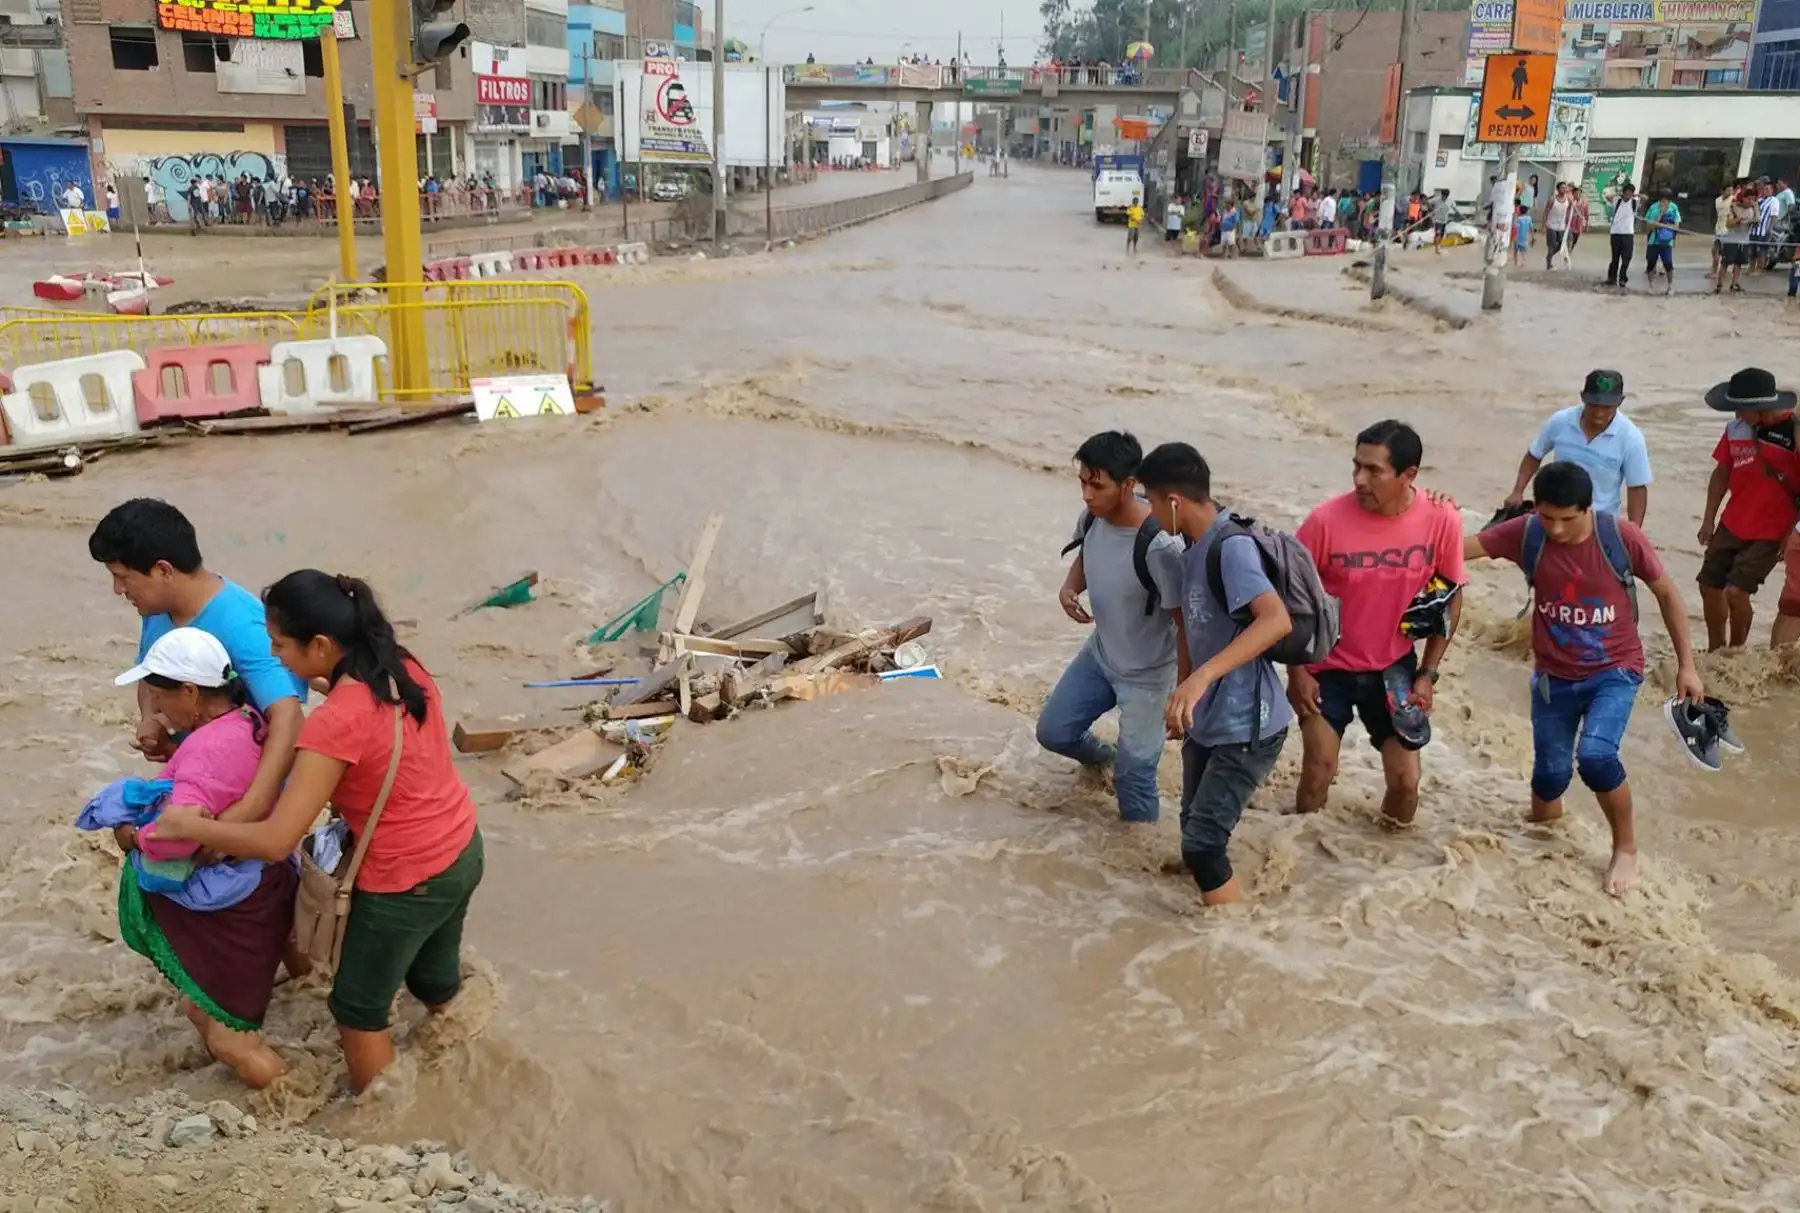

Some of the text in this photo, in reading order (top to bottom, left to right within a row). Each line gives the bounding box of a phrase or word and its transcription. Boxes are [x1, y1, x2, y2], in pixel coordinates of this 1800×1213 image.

[158, 4, 254, 25] CELINDA
[1571, 3, 1654, 20] MUEBLERIA
[160, 17, 254, 37] VARGAS
[481, 79, 529, 101] FILTROS
[1487, 123, 1538, 138] PEATON
[1538, 604, 1616, 626] JORDAN
